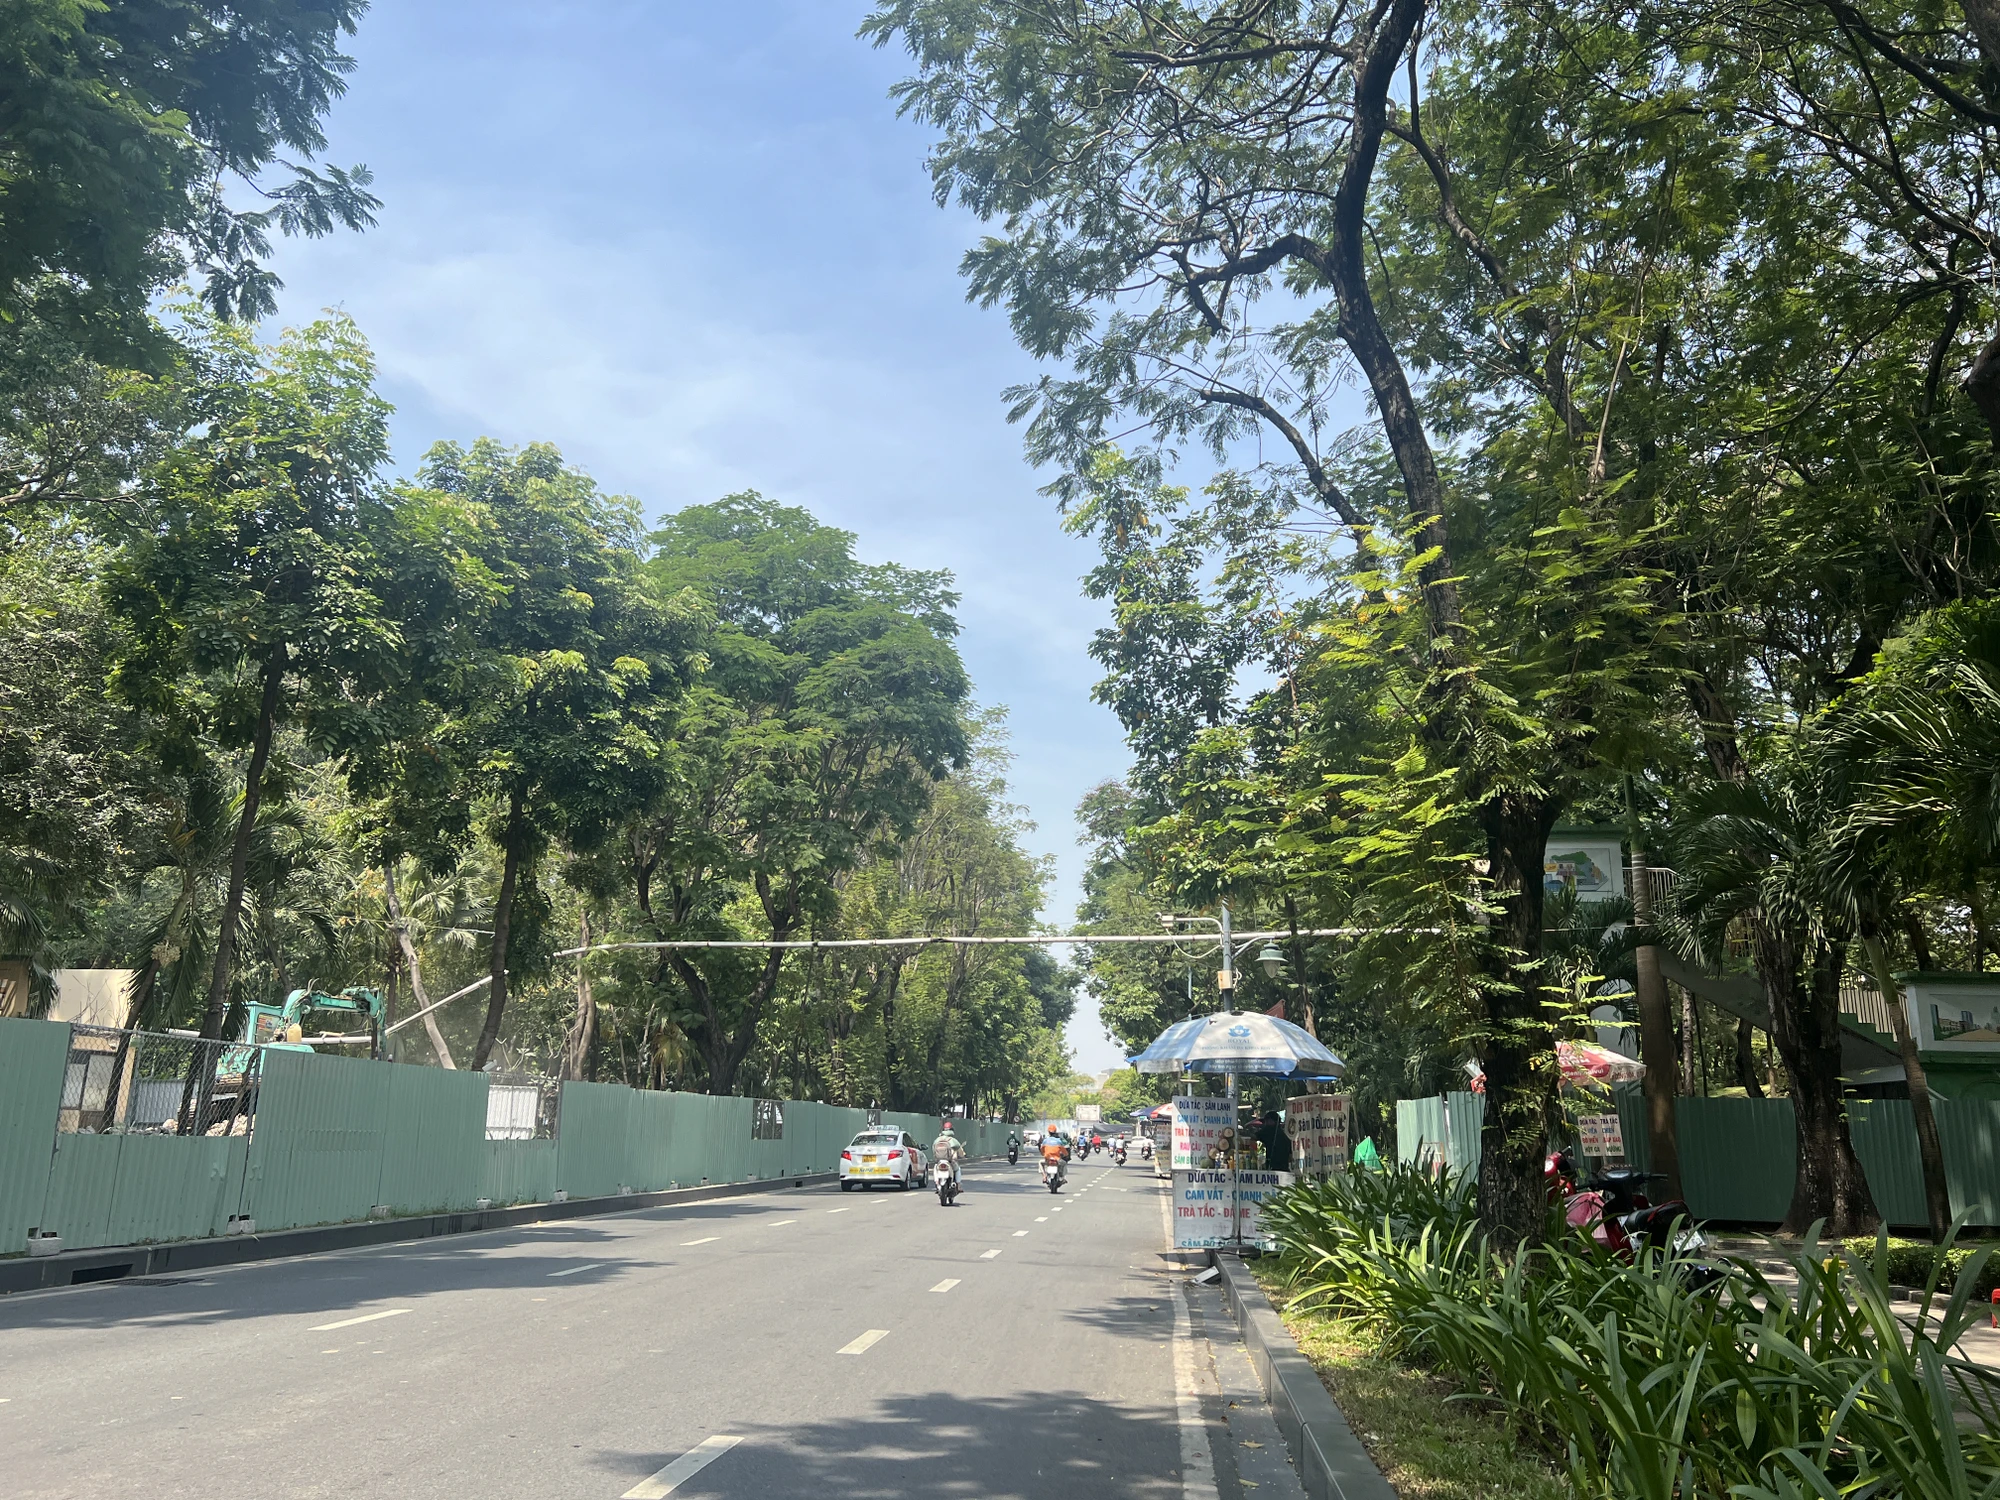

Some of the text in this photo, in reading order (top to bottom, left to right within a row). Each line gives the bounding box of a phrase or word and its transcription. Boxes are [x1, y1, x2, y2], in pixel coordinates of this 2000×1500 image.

[1217, 1102, 1231, 1112] LẠNH
[1204, 1116, 1221, 1124] CHANH
[1256, 1174, 1279, 1186] LẠNH
[1186, 1190, 1204, 1200] CAM
[1178, 1204, 1195, 1217] TRÀ
[1197, 1202, 1215, 1218] TẮC
